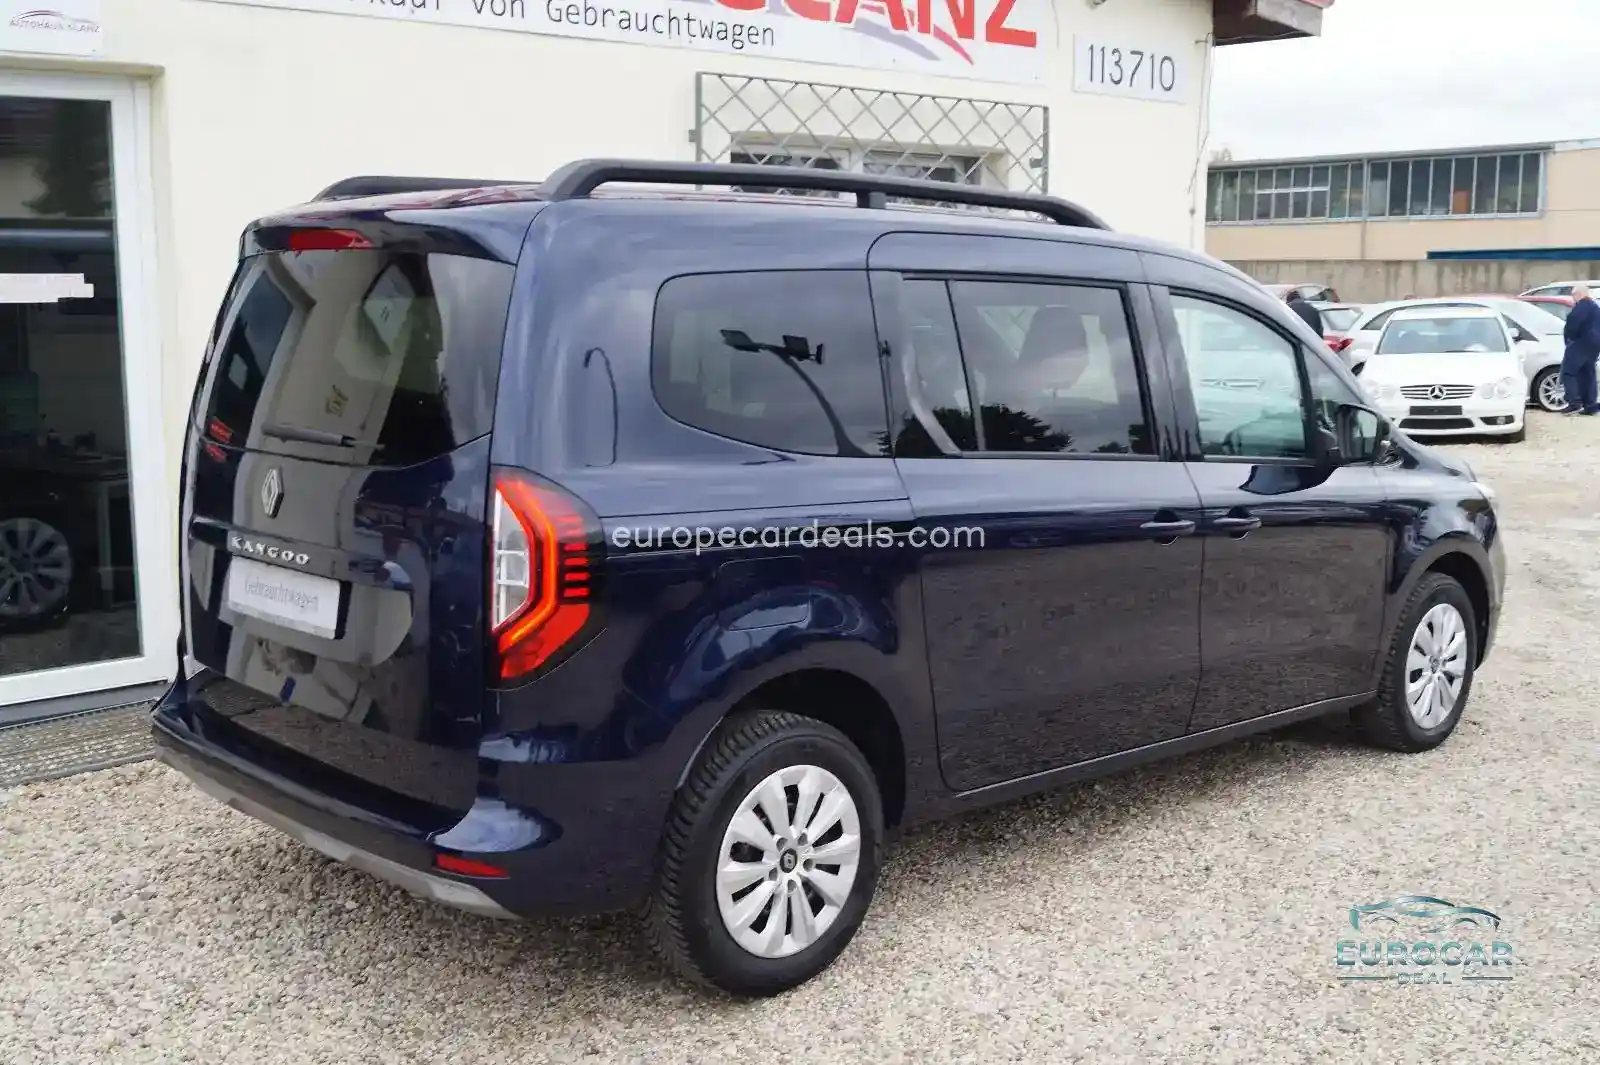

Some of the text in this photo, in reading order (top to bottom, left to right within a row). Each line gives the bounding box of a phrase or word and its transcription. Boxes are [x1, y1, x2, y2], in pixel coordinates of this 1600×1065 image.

[472, 0, 775, 49] von Gebrauchtwagen
[717, 0, 1037, 48] ANZ
[1087, 43, 1177, 92] 113710
[231, 536, 310, 565] KANGOO
